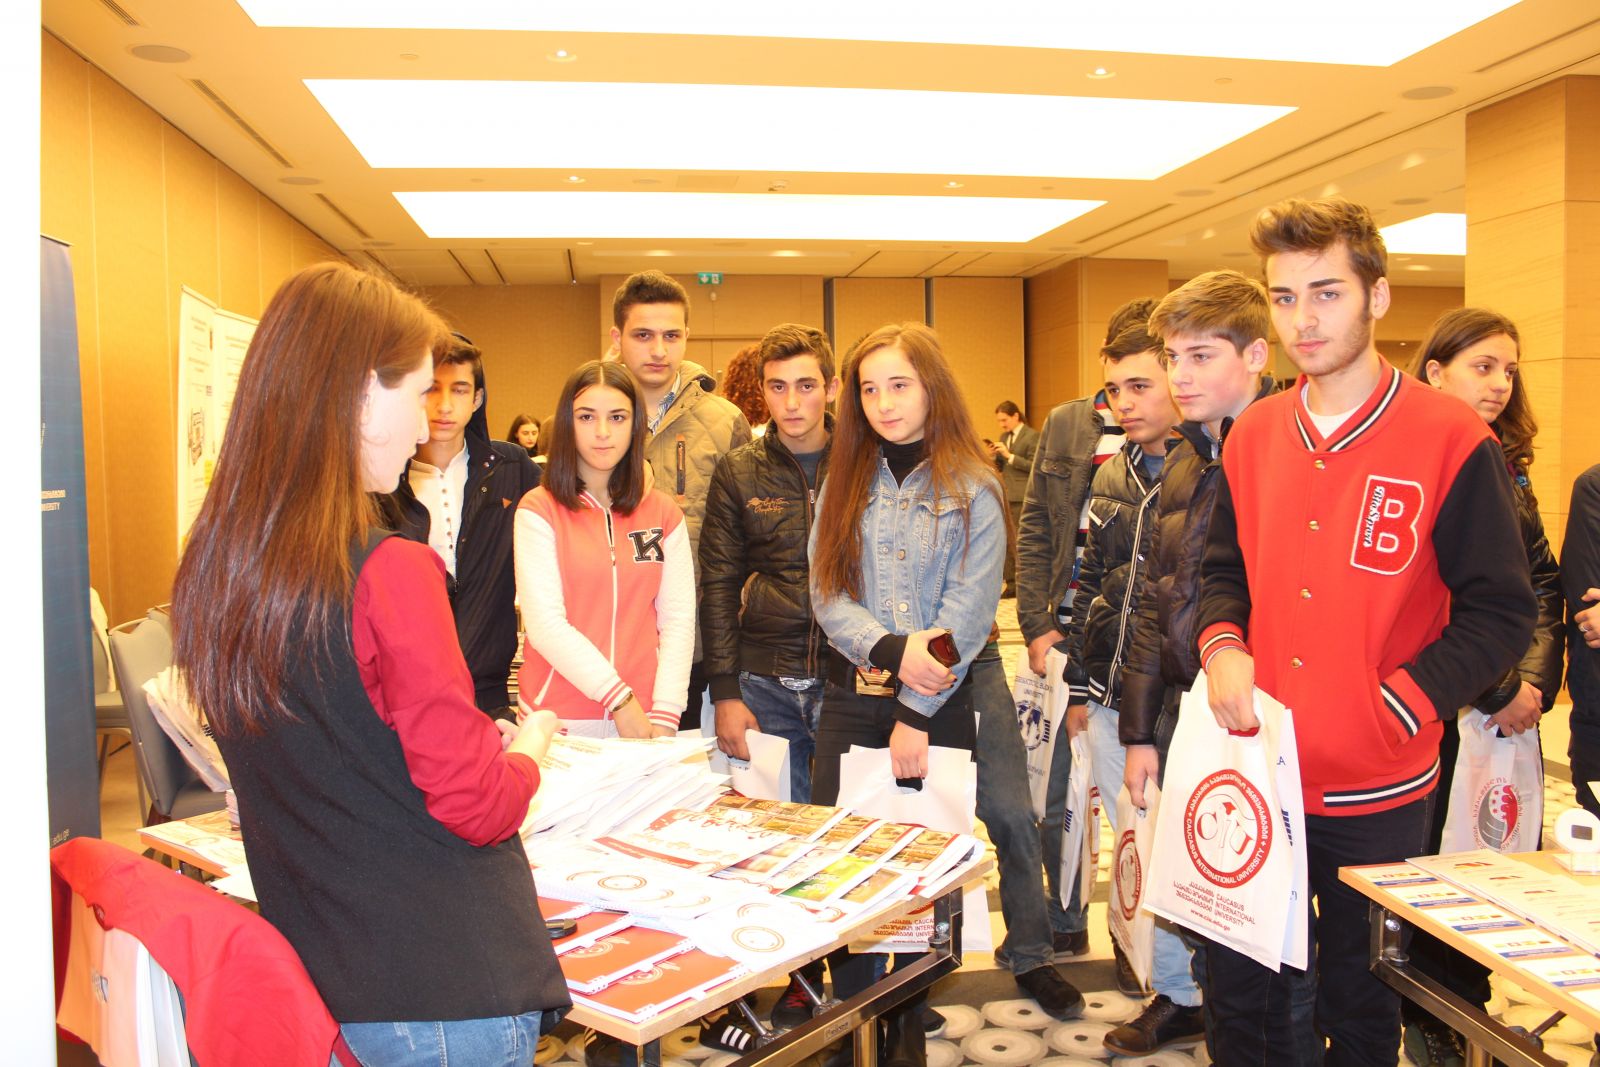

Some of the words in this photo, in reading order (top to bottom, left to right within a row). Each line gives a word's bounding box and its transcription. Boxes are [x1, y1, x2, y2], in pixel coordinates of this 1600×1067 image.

[1350, 474, 1424, 575] B
[627, 527, 665, 563] K
[1186, 818, 1199, 860] CAUCASUS
[1236, 847, 1265, 882] UNIVERSITY
[1215, 900, 1256, 925] INTERNATIONAL
[1216, 893, 1245, 912] CAUCASUS
[1214, 909, 1245, 927] UNIVERSITY
